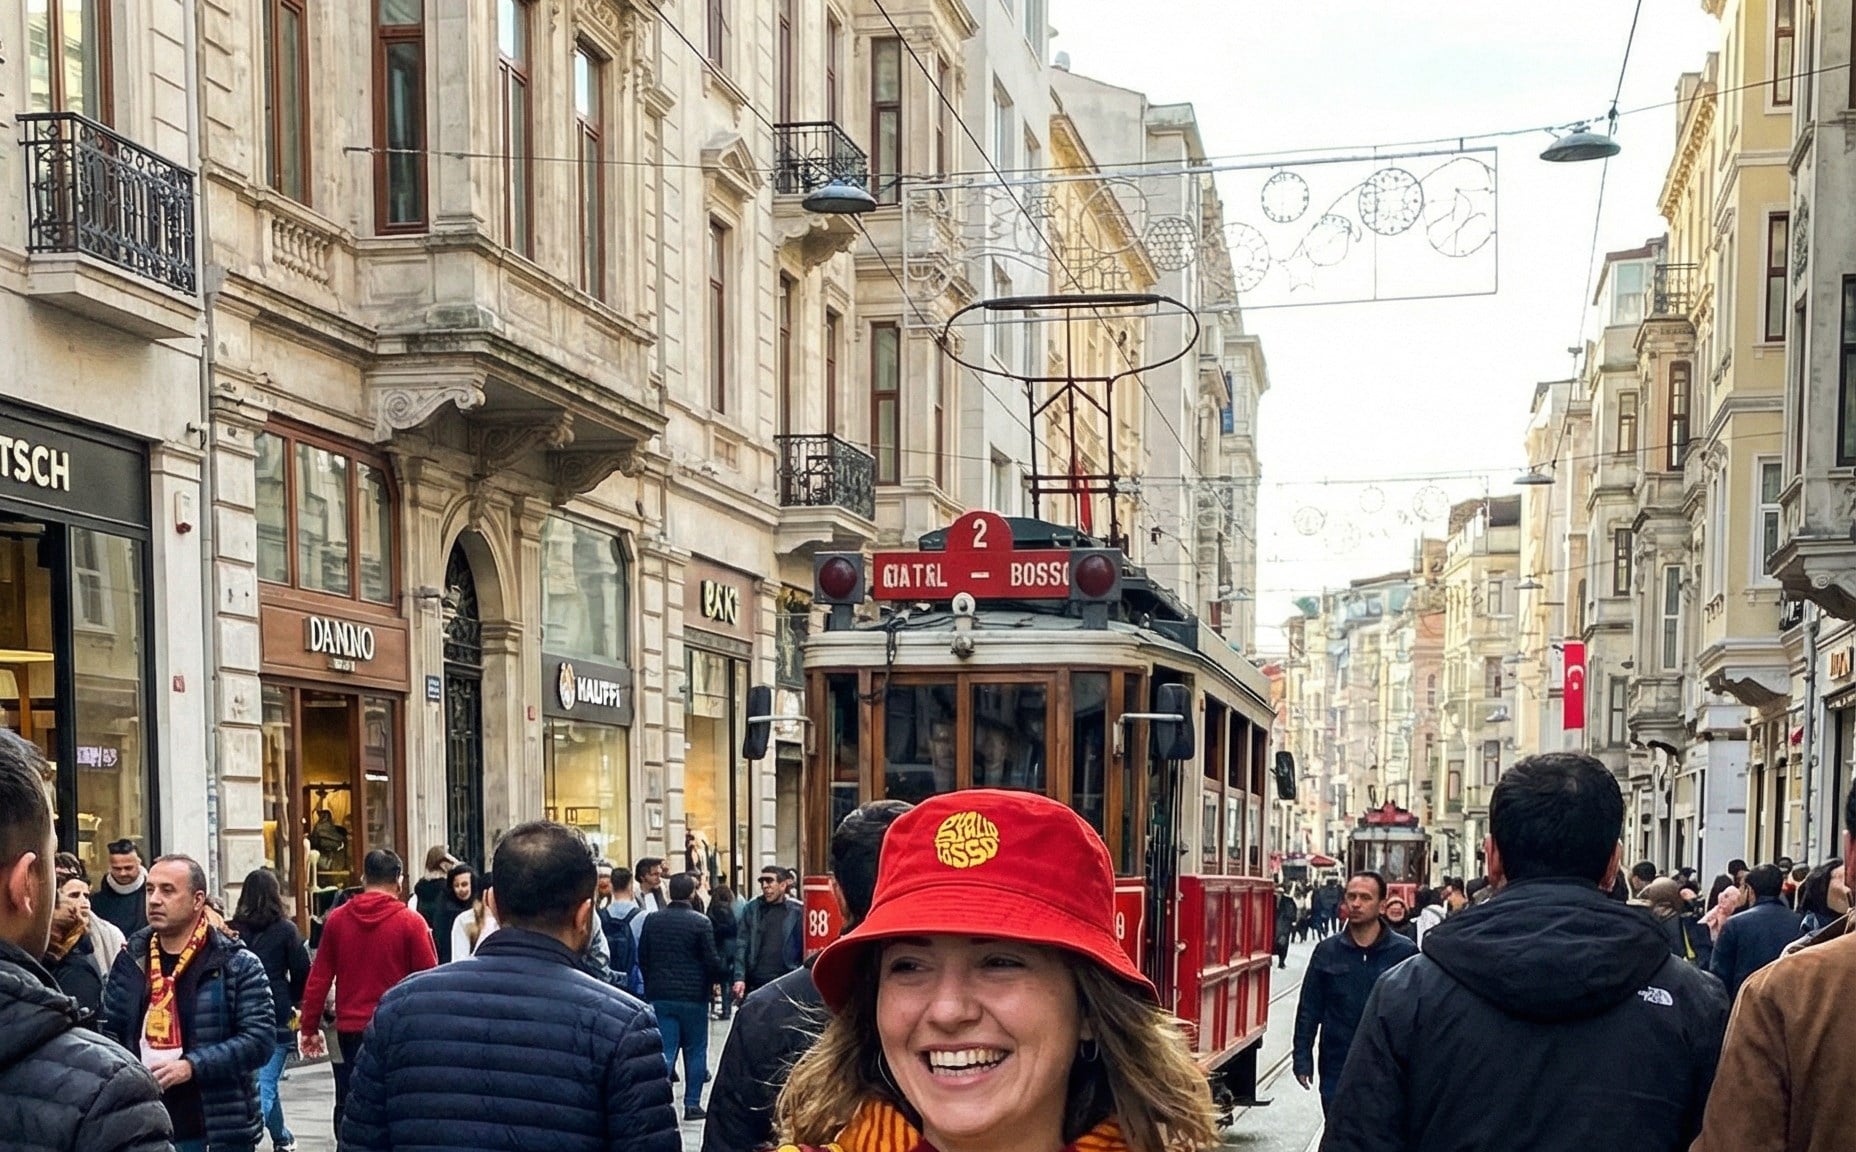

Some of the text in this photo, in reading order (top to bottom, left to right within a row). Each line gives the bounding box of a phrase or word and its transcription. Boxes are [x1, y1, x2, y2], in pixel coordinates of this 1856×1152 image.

[0, 434, 70, 492] TSCH
[972, 518, 988, 548] 2
[809, 909, 829, 937] 88
